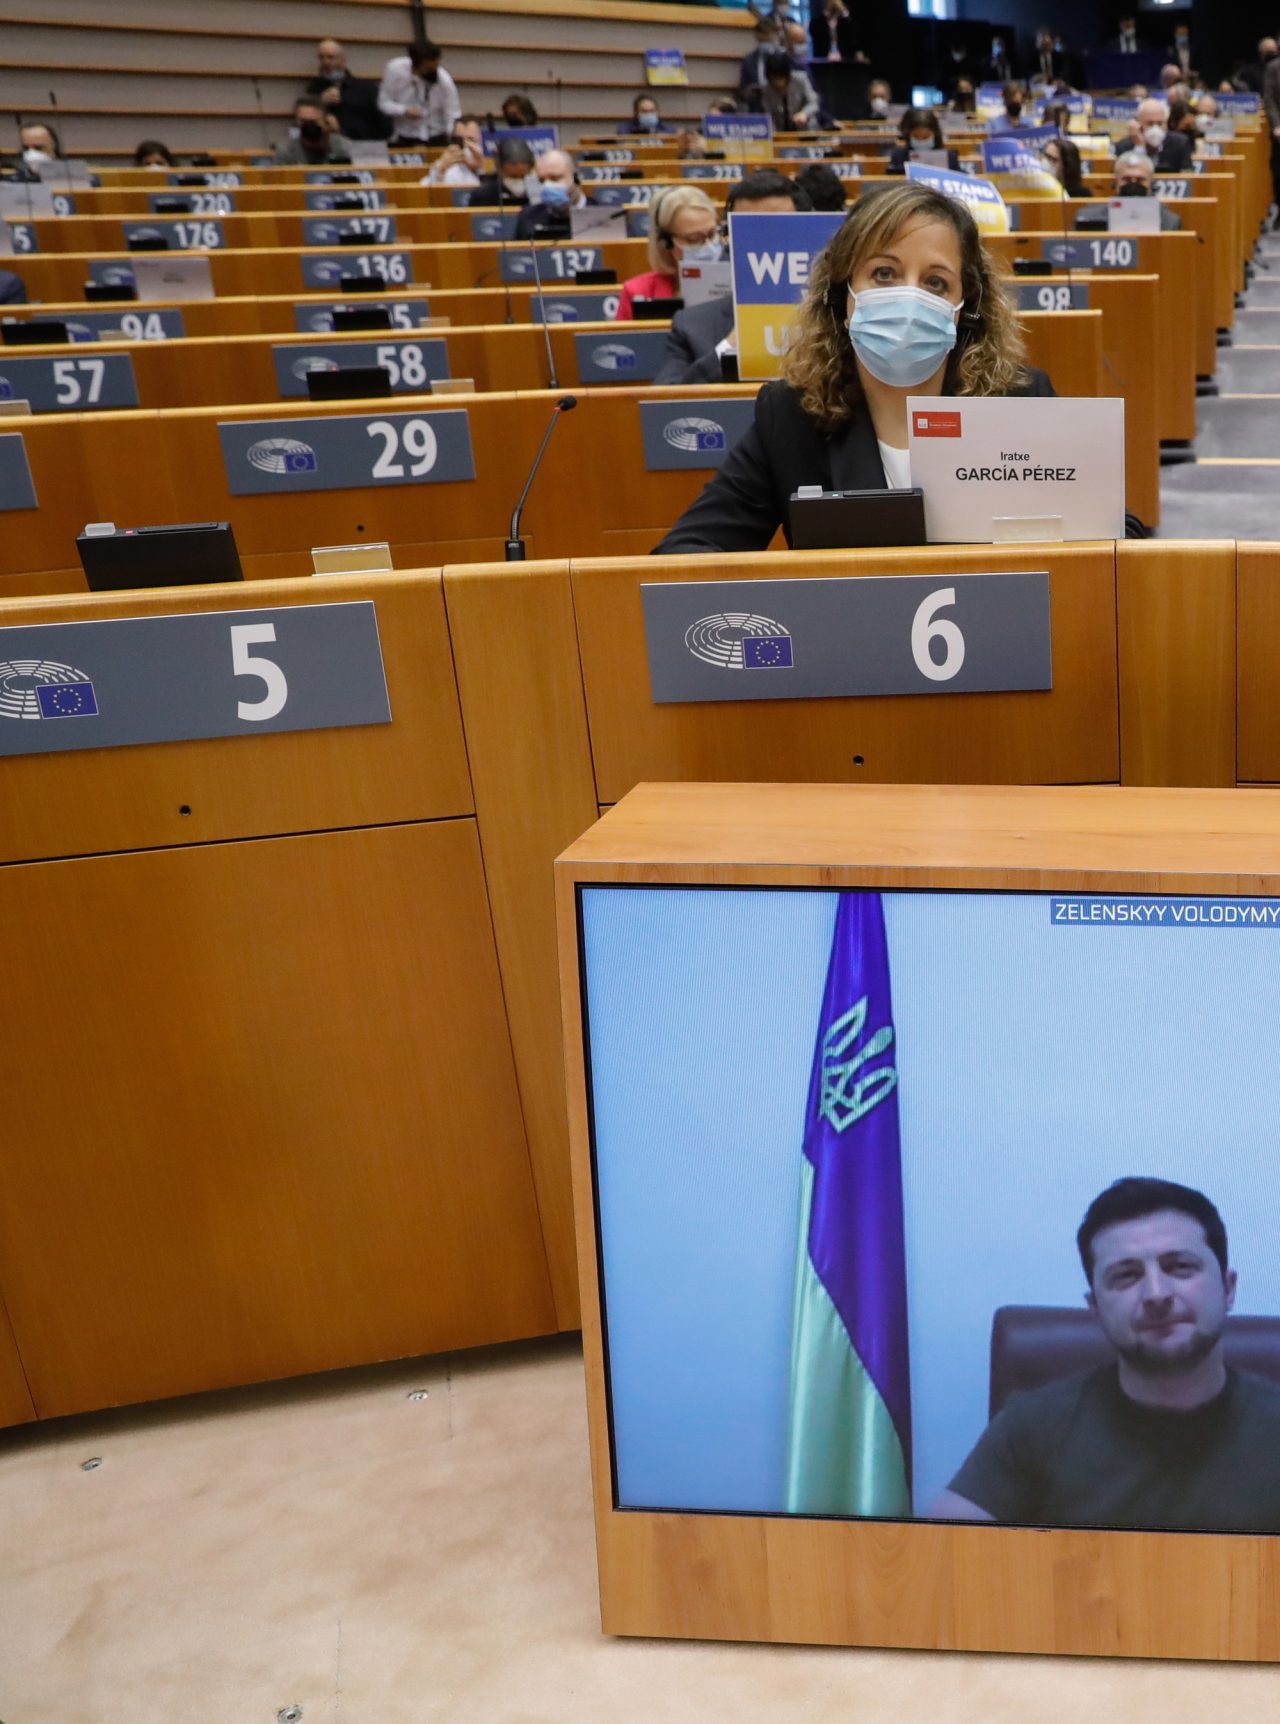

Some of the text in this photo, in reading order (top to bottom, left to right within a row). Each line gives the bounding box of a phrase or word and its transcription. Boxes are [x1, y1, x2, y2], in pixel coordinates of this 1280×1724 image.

[174, 222, 220, 249] 176
[551, 249, 596, 278] 137
[1090, 240, 1133, 267] 140
[747, 252, 810, 286] WE
[121, 313, 166, 340] 94
[376, 345, 427, 388] 58
[53, 359, 106, 404] 57
[366, 419, 438, 479] 29
[1000, 451, 1030, 462] Iratxe
[955, 465, 1076, 481] GARCÍA PÉREZ
[910, 586, 966, 682] 6
[230, 622, 289, 722] 5
[1055, 903, 1168, 922] ZELENSKYY
